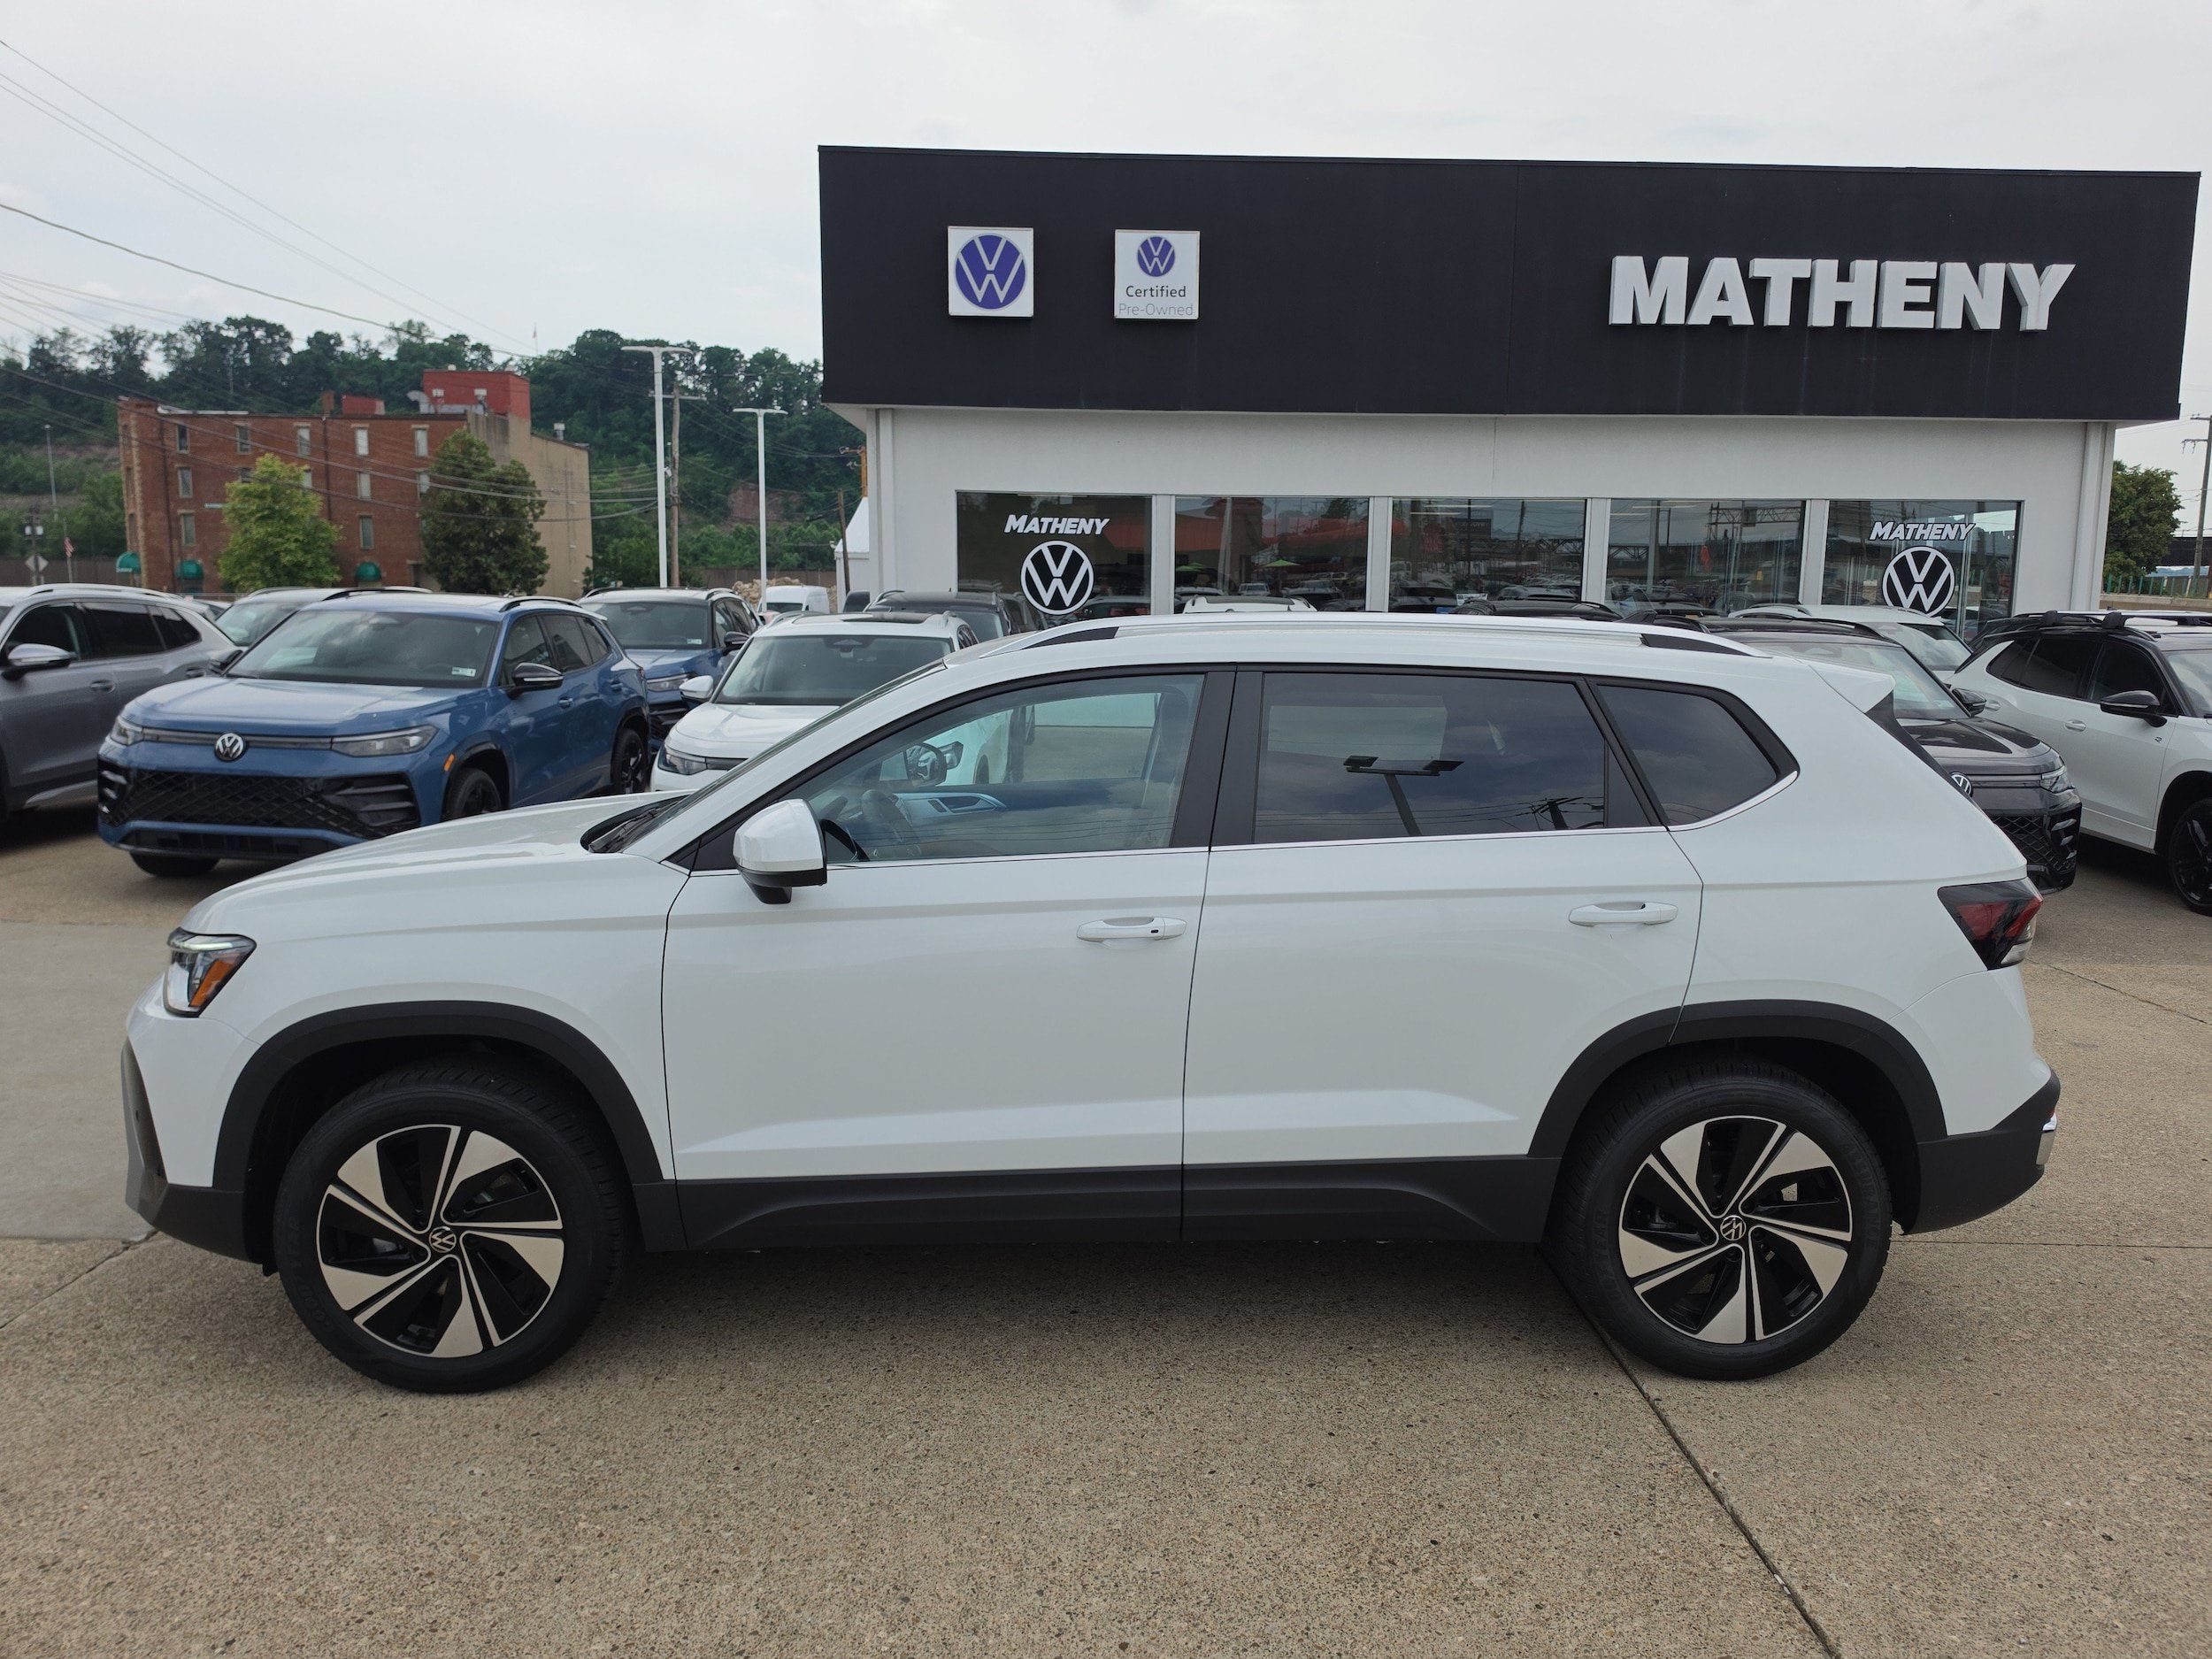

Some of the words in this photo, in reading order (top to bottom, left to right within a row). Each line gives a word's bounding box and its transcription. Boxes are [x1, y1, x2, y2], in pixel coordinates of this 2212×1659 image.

[956, 234, 1025, 306] VW
[1138, 236, 1175, 275] VW
[1125, 286, 1187, 297] Certified
[1609, 256, 2076, 331] MATHENY
[1118, 303, 1194, 316] Pre-Owned
[1004, 514, 1110, 534] MATHENY
[1869, 521, 1975, 541] MATHENY
[1023, 541, 1093, 612] VW
[1884, 547, 1955, 614] VW
[216, 733, 243, 759] VW
